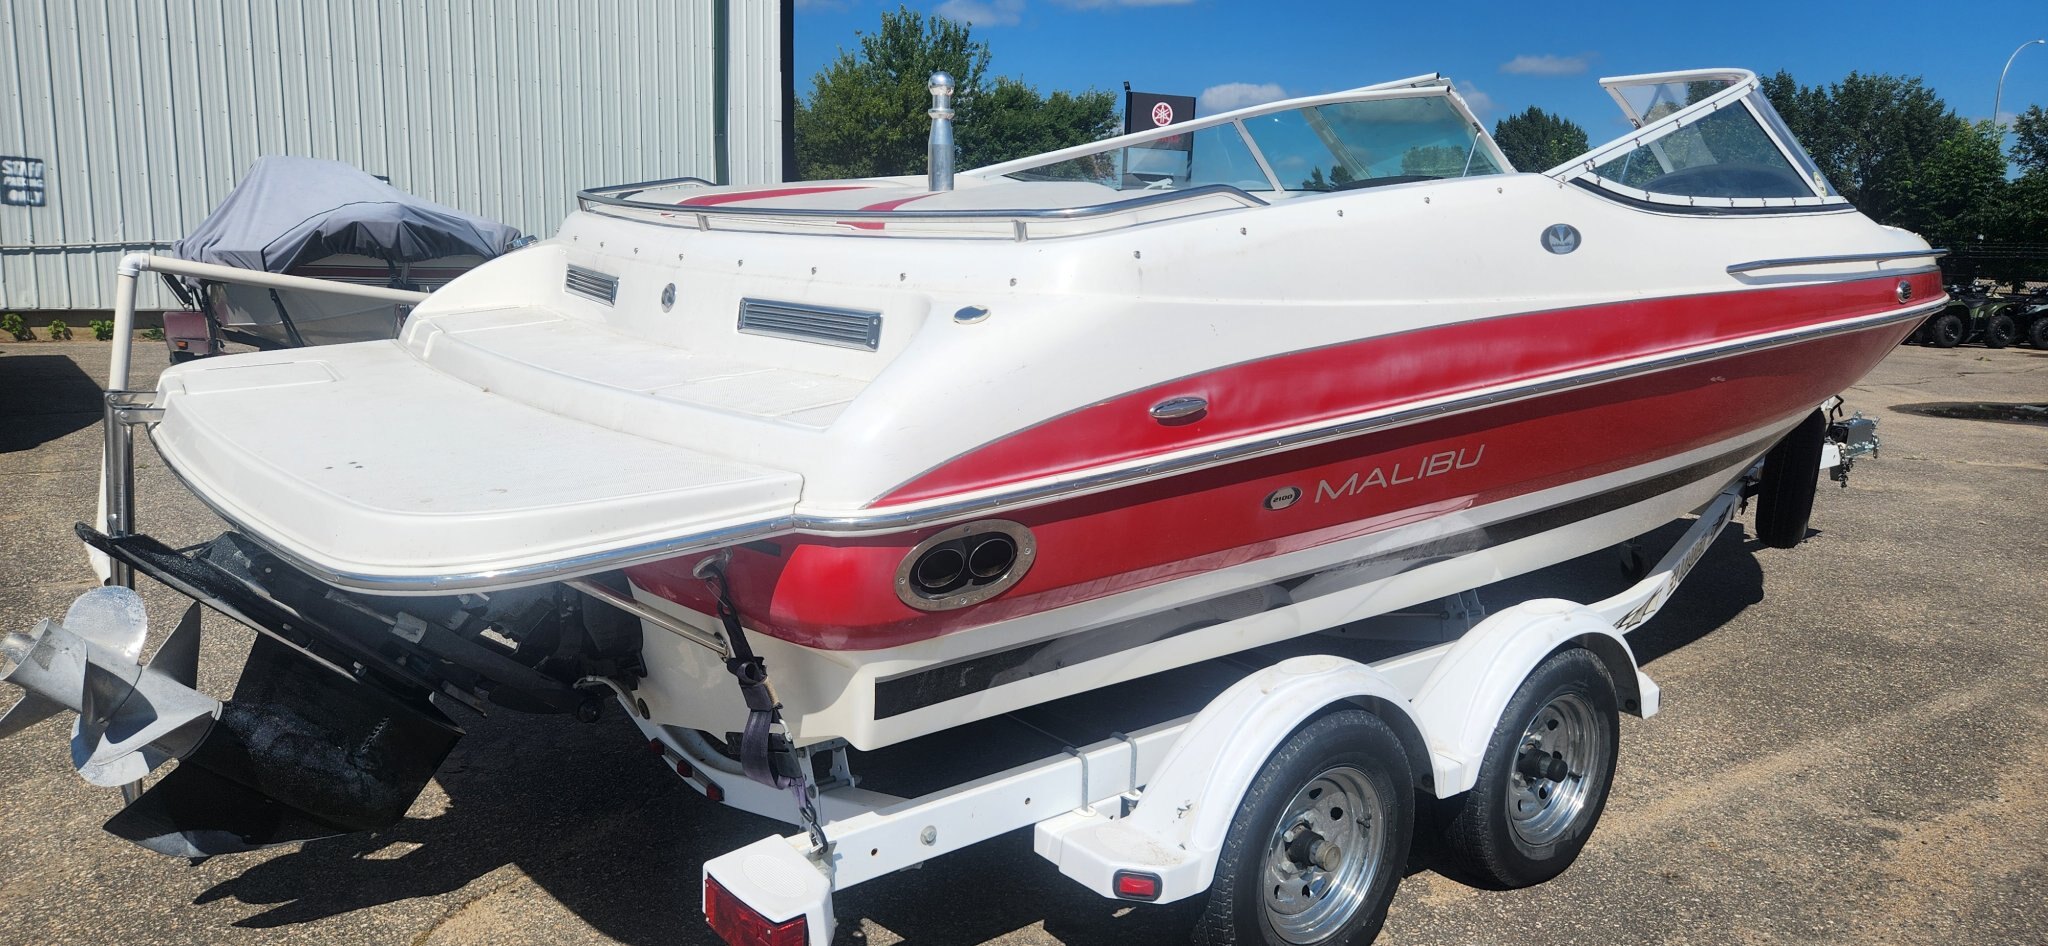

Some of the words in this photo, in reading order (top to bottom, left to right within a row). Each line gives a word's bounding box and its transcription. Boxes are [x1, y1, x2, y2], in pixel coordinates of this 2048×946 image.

[2, 160, 43, 177] STAFF
[8, 189, 42, 203] ONLY
[1314, 444, 1485, 503] MALIBU
[1273, 494, 1293, 503] 2100
